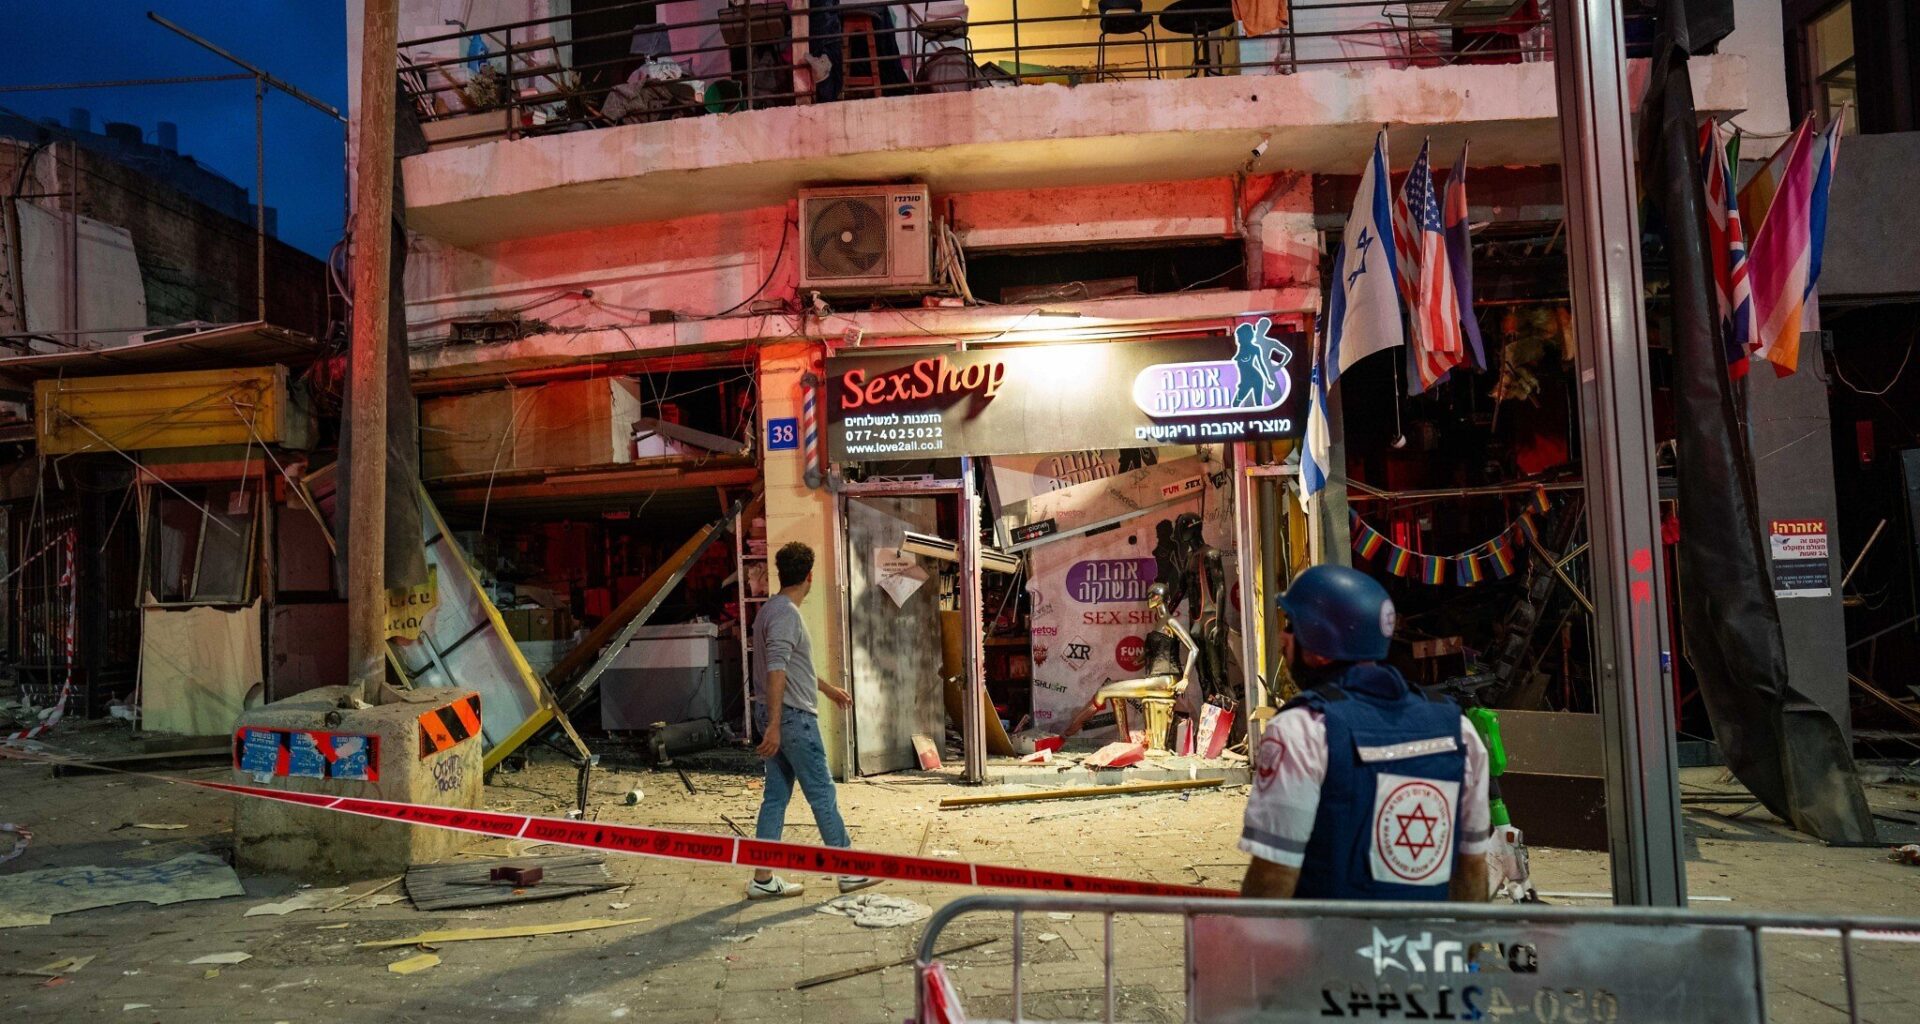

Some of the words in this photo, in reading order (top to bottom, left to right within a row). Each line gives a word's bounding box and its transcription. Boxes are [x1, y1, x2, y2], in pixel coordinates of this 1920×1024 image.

[894, 195, 921, 203] טורנדו
[841, 354, 1007, 409] SexShop
[1161, 368, 1222, 390] אהבה
[1154, 387, 1232, 414] ותשוקה
[844, 413, 900, 427] למשלוחים
[902, 413, 942, 425] הזמנות
[1248, 418, 1291, 433] מוצרי
[772, 425, 794, 443] 38
[845, 427, 943, 441] 077-4025022
[1135, 423, 1196, 441] וריגושים
[1201, 421, 1244, 436] אהבה
[846, 440, 943, 454] www.love2all.co.il
[1162, 485, 1180, 496] FUN
[1184, 479, 1202, 490] SEX
[1772, 521, 1823, 533] אזהרה!
[1086, 561, 1139, 581] אהבה
[1078, 579, 1147, 604] ותשוקה
[1082, 610, 1123, 625] SEX
[1032, 625, 1058, 636] vetoy
[1067, 643, 1091, 660] XR
[1120, 646, 1144, 657] FUN
[534, 824, 567, 839] מעבר
[568, 827, 587, 843] אין
[610, 832, 649, 849] ישראל
[673, 838, 724, 858] משטרת
[786, 851, 806, 869] אין
[831, 854, 876, 872] ישראל
